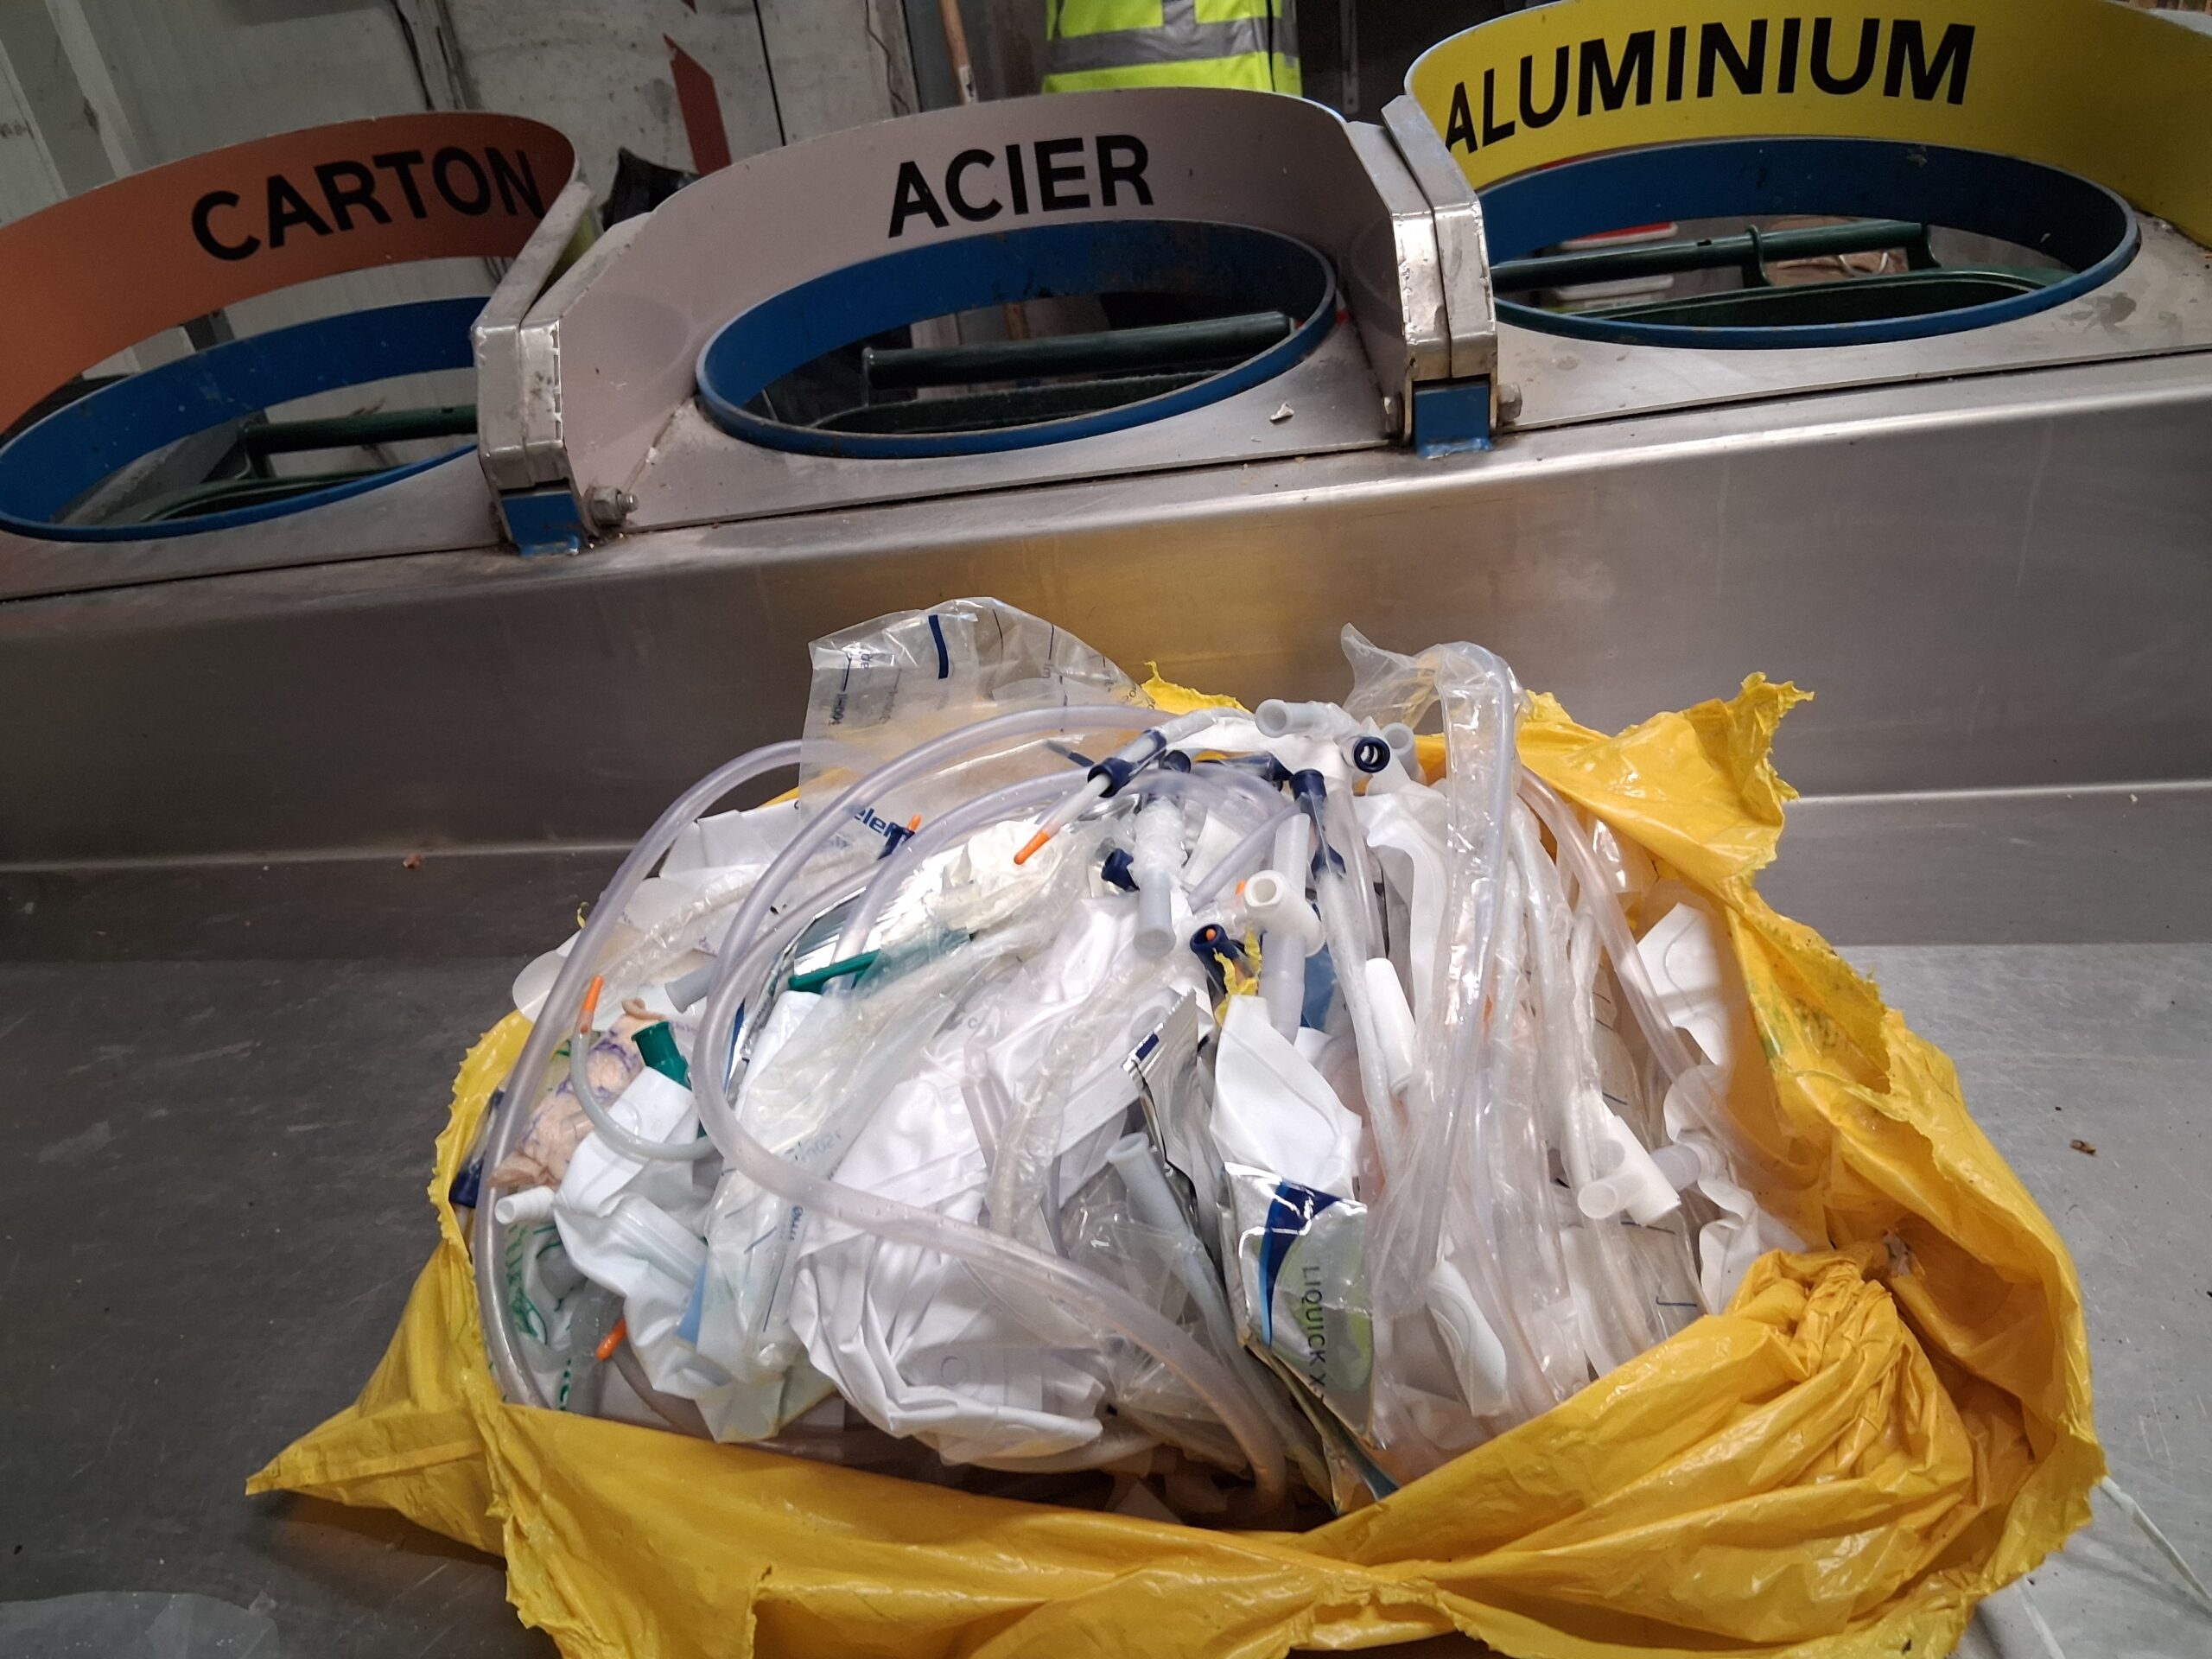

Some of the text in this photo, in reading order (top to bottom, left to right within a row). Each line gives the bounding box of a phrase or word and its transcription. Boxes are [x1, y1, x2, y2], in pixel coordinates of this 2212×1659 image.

[1445, 17, 1975, 155] ALUMINIUM
[192, 146, 546, 261] CARTON
[888, 134, 1154, 238] ACIER
[1301, 1266, 1326, 1367] LIQUICK
